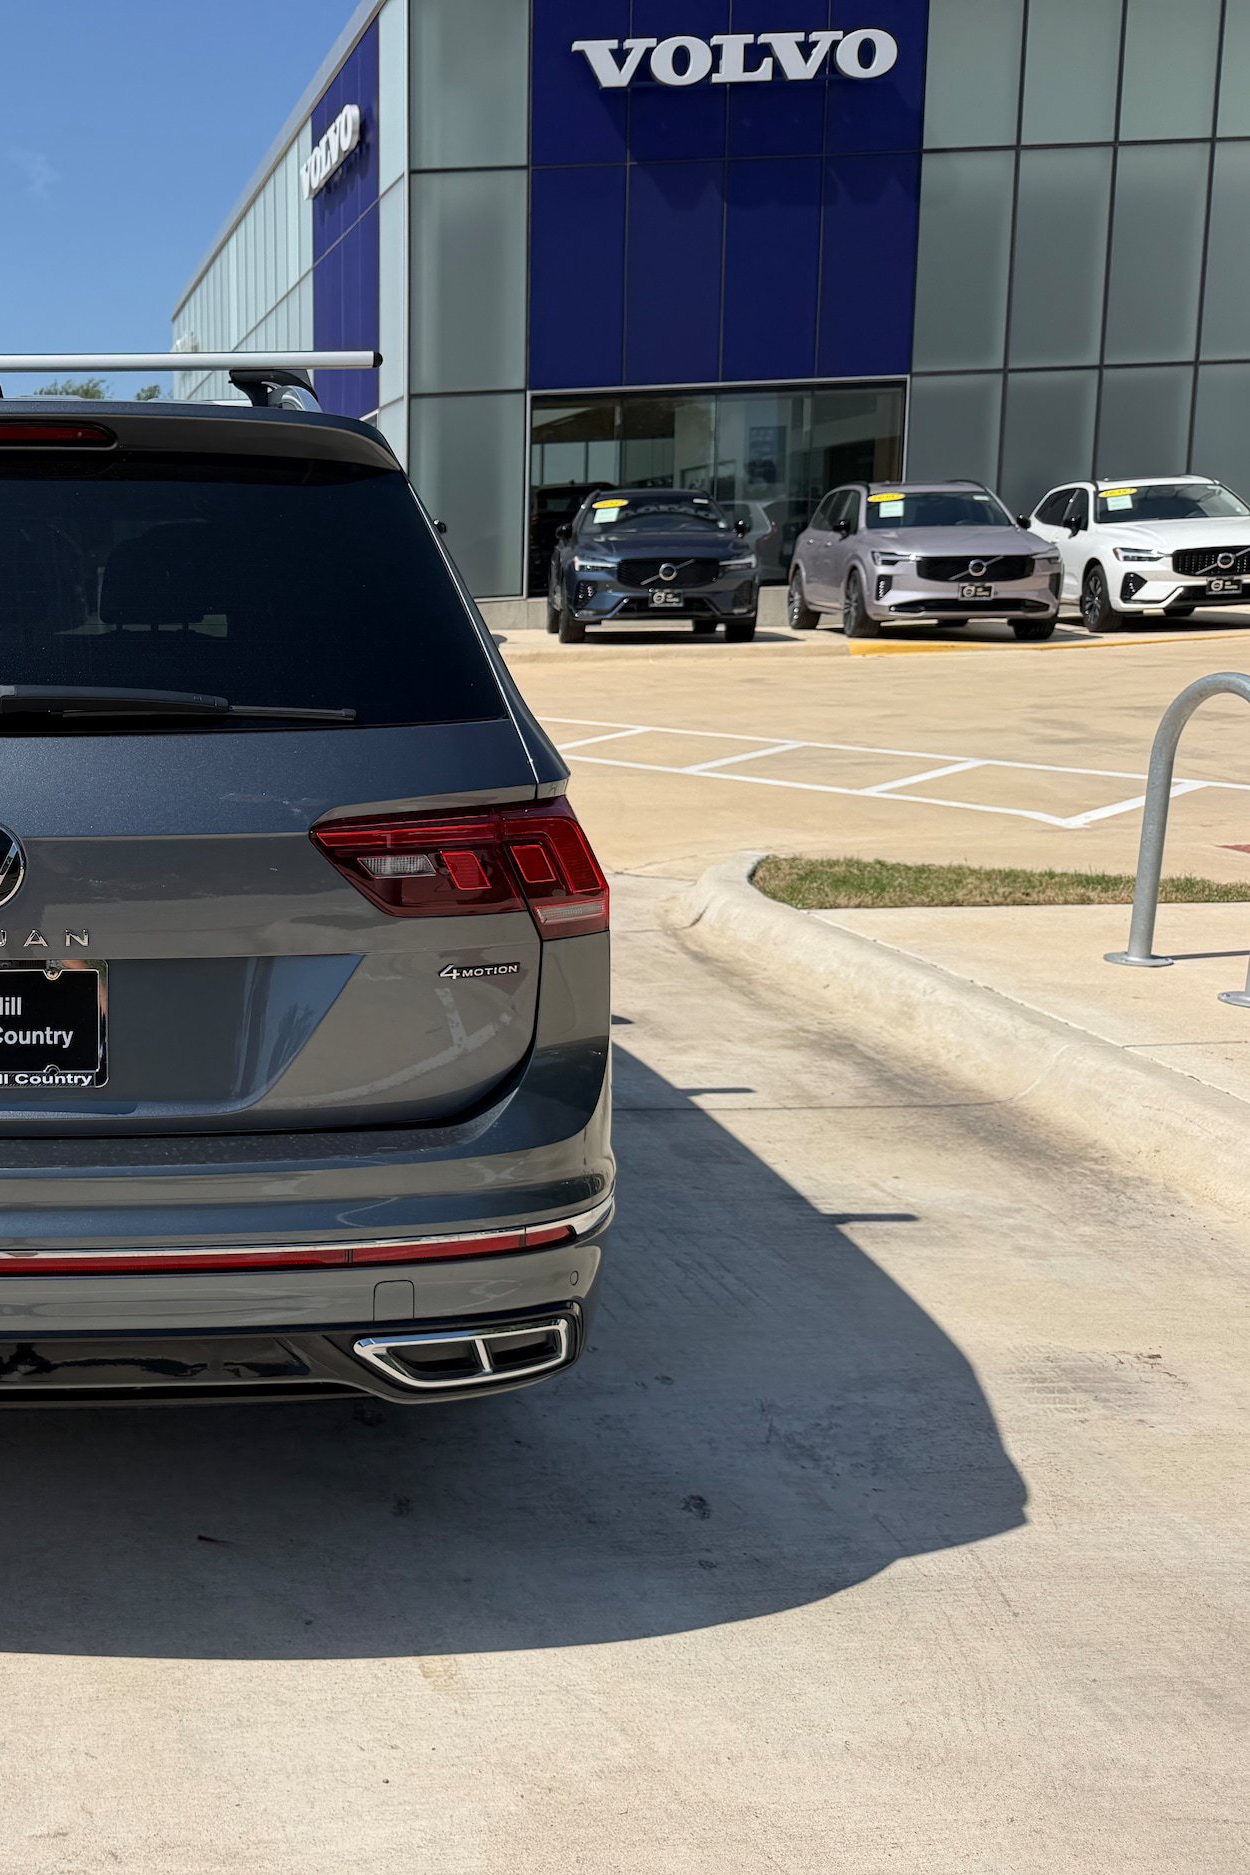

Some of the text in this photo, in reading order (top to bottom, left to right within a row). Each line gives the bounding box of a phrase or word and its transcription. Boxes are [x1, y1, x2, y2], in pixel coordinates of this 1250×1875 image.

[571, 28, 899, 89] VOLVO
[300, 104, 360, 200] VOLVO
[14, 1073, 93, 1087] Country
